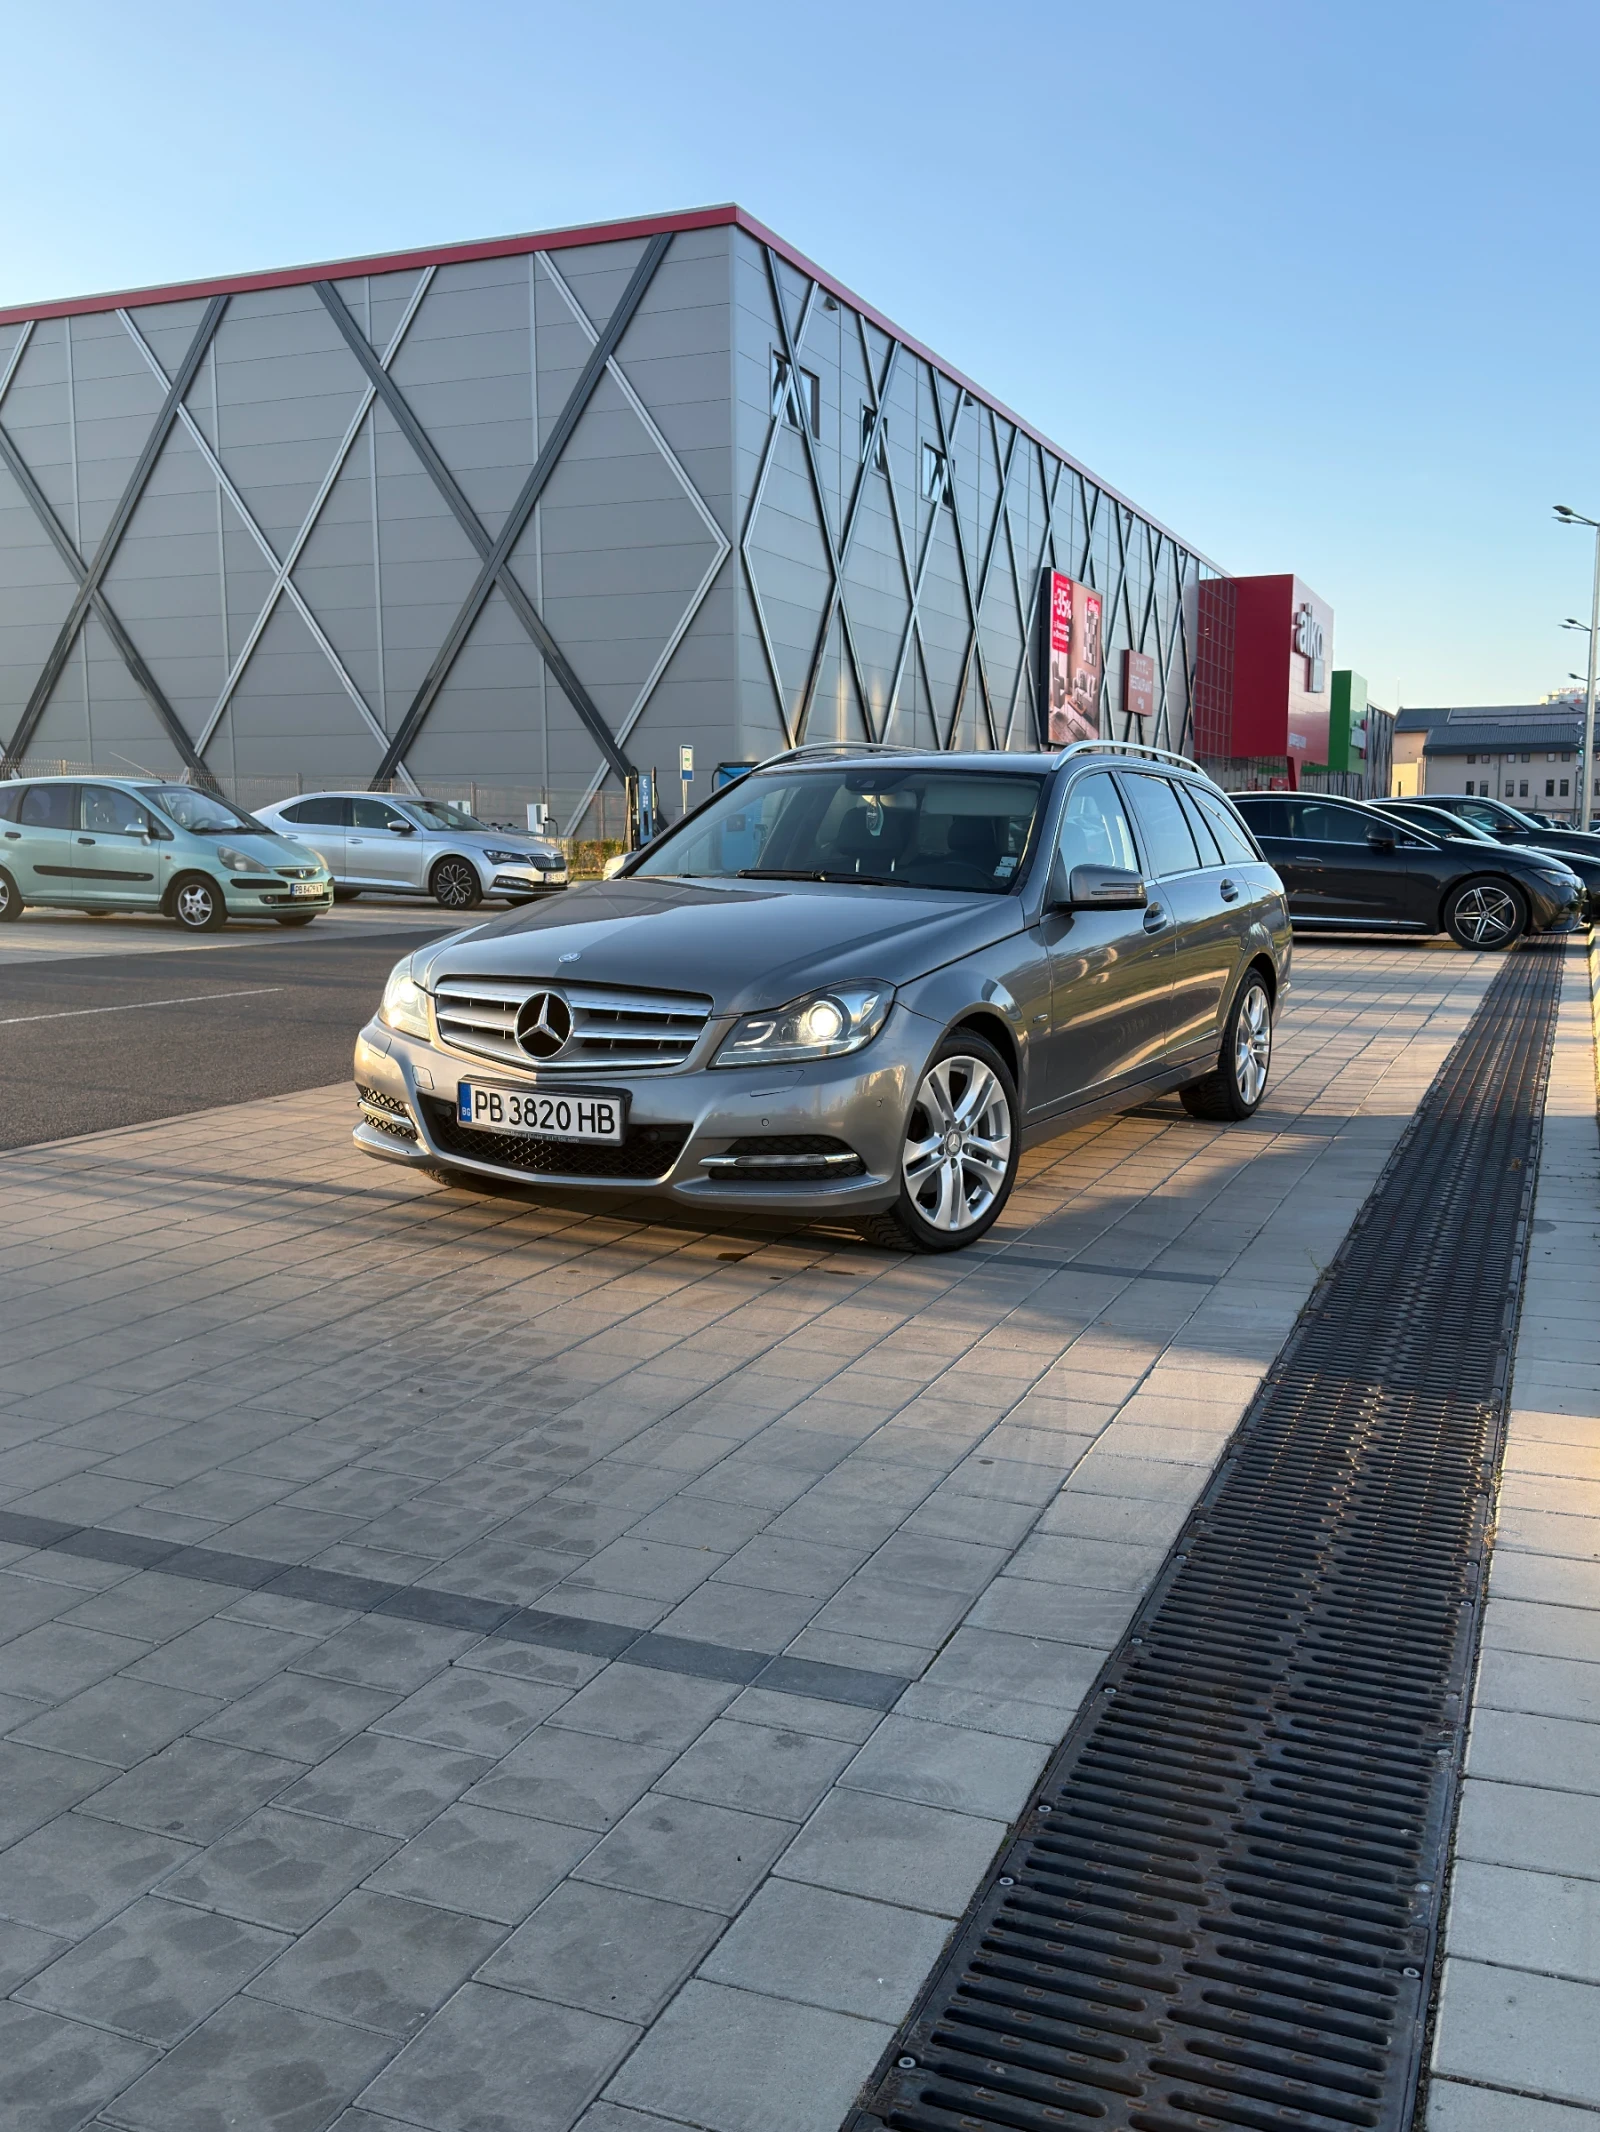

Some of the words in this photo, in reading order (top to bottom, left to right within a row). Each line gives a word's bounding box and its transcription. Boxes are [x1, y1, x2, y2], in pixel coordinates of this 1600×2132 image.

[1294, 602, 1324, 660] aiko
[461, 1106, 471, 1116] BG
[475, 1090, 503, 1122] PB
[509, 1096, 572, 1131] 3820
[578, 1102, 616, 1134] HB
